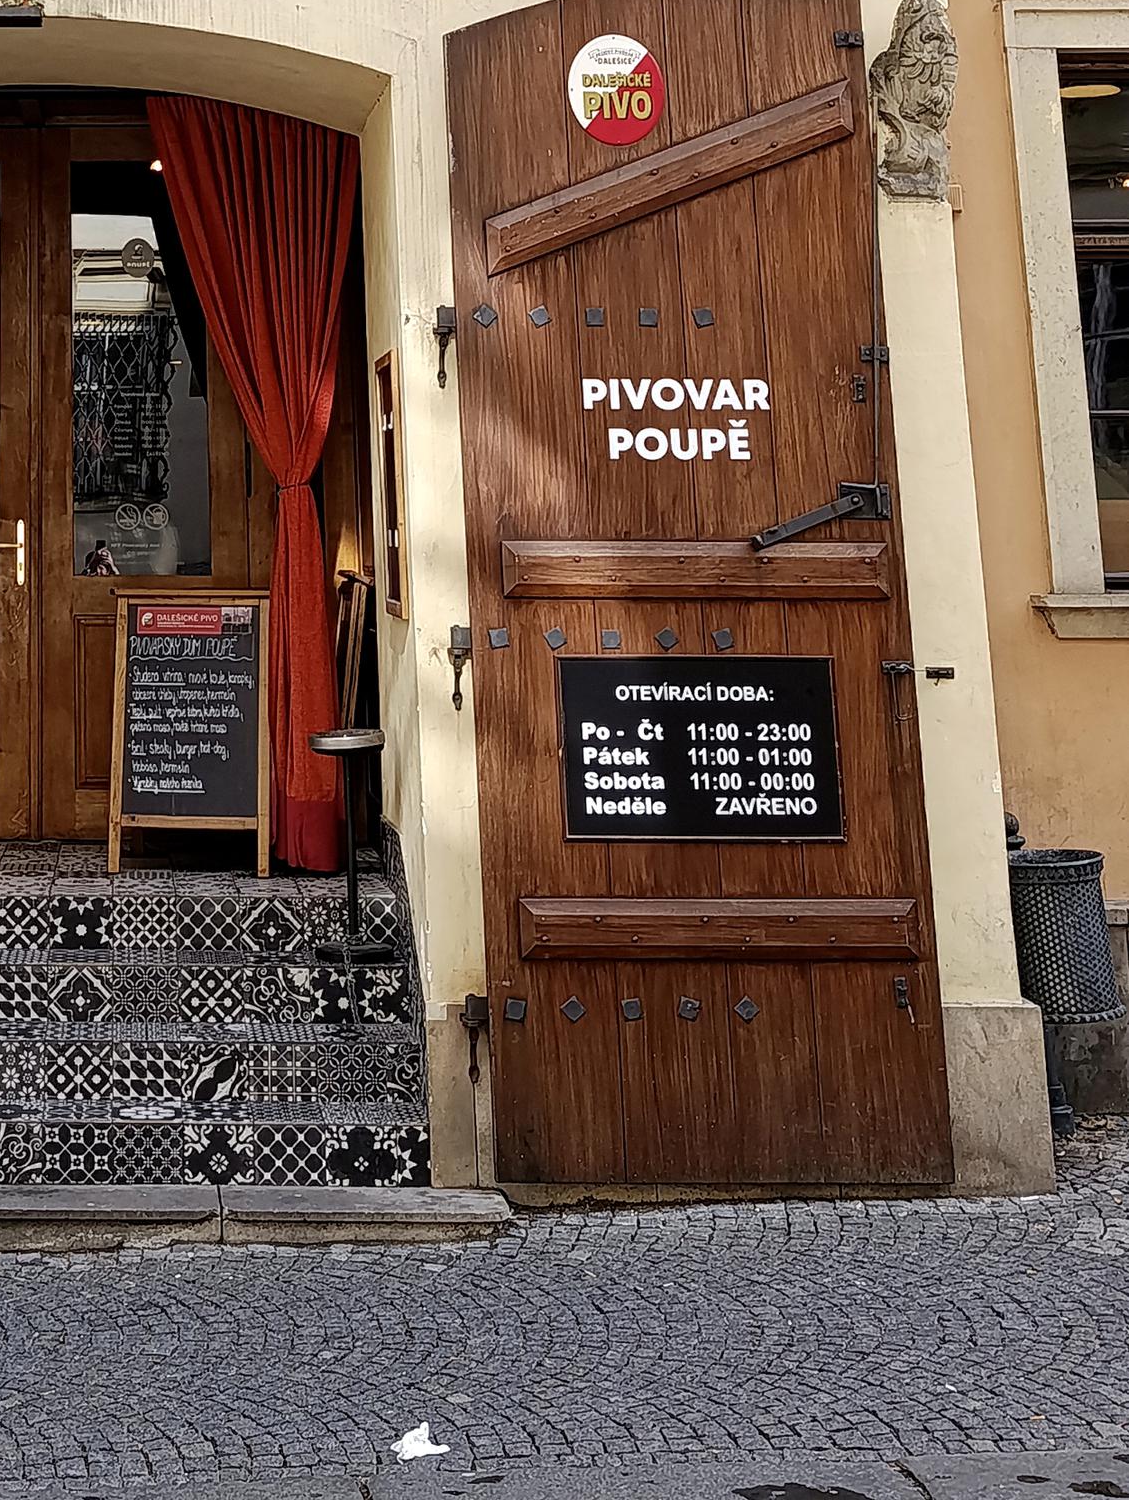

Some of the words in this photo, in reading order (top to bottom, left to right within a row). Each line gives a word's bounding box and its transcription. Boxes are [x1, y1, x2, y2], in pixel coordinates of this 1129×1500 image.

[582, 71, 652, 88] DALEŠICKÉ
[582, 90, 653, 120] PIVO
[582, 378, 771, 411] PIVOVAR
[608, 419, 752, 461] POUPĚ
[156, 613, 199, 622] DALEŠICKÉ
[200, 614, 219, 622] PIVO
[615, 682, 712, 701] OTEVÍRACÍ
[717, 686, 775, 702] DOBA:
[581, 722, 610, 741] Po
[637, 719, 664, 741] Čt
[687, 723, 739, 741] 11:00
[757, 723, 812, 741] 23:00
[583, 747, 650, 766] Pátek
[687, 748, 740, 766] 11:00
[758, 748, 812, 766] 01:00
[584, 772, 665, 790] Sobota
[689, 772, 742, 791] 11:00
[760, 772, 815, 791] 00:00
[585, 796, 667, 815] Neděle
[715, 793, 818, 816] ZAVŘENO
